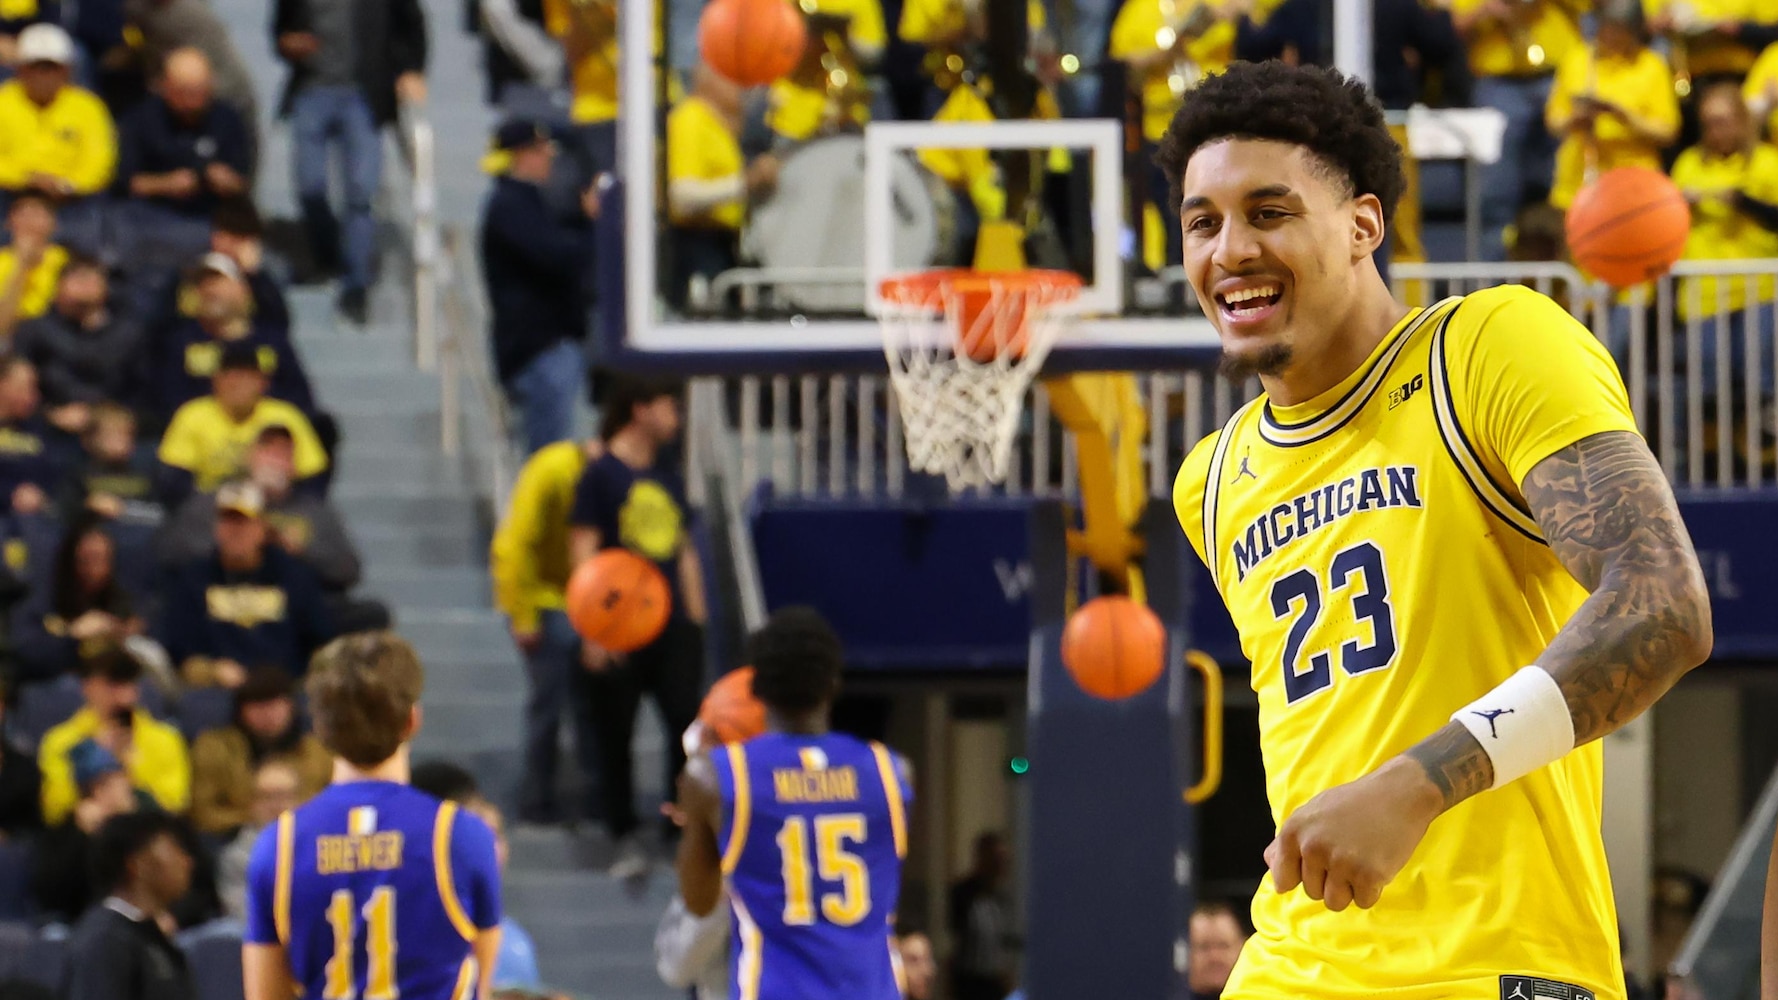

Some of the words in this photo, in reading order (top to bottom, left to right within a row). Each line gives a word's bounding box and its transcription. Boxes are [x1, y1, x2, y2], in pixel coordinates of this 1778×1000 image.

[1231, 465, 1424, 584] MICHIGAN
[1269, 538, 1399, 707] 23
[775, 812, 873, 928] 15
